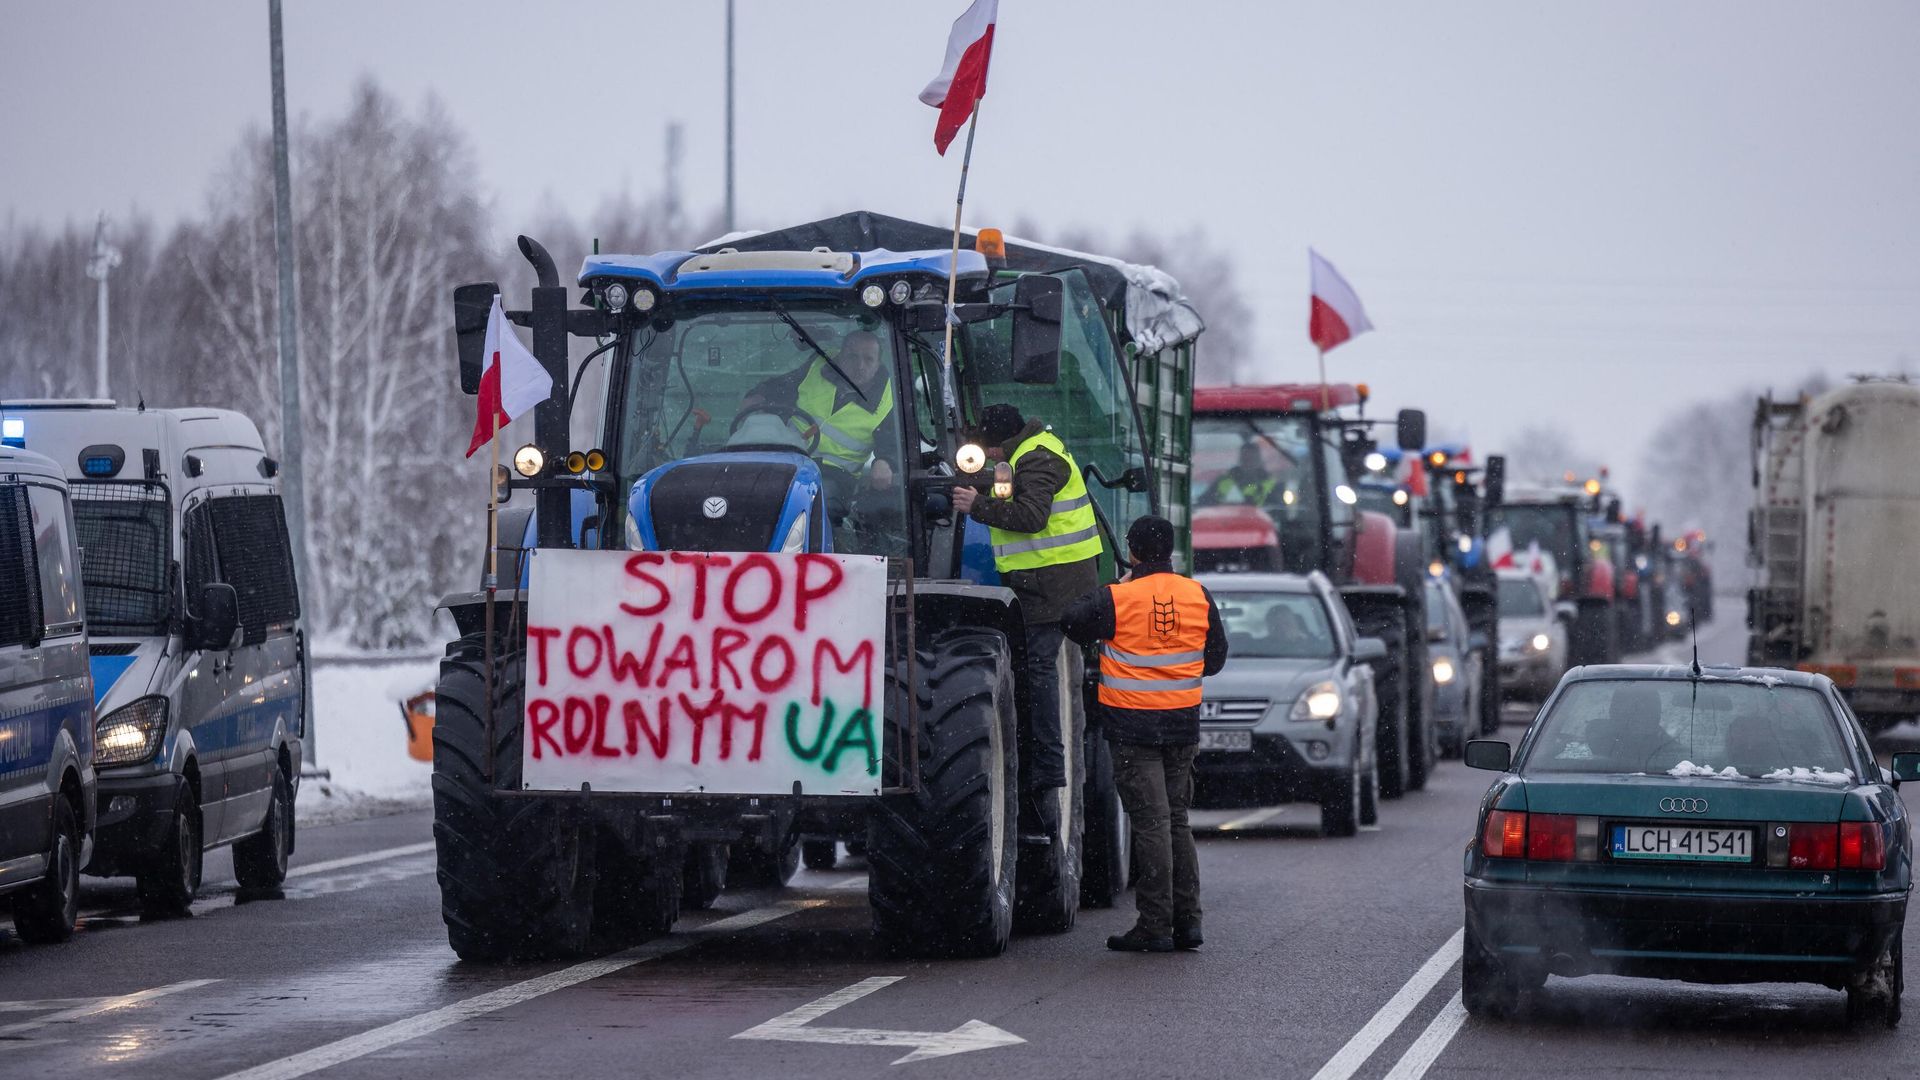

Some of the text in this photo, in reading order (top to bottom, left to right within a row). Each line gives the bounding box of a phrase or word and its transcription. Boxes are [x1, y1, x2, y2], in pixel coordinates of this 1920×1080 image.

[619, 552, 845, 632] STOP
[527, 622, 875, 710] TOWAROM
[527, 689, 880, 776] ROLNYM UA
[1615, 843, 1624, 851] PL
[1627, 829, 1746, 855] LCH 41541
